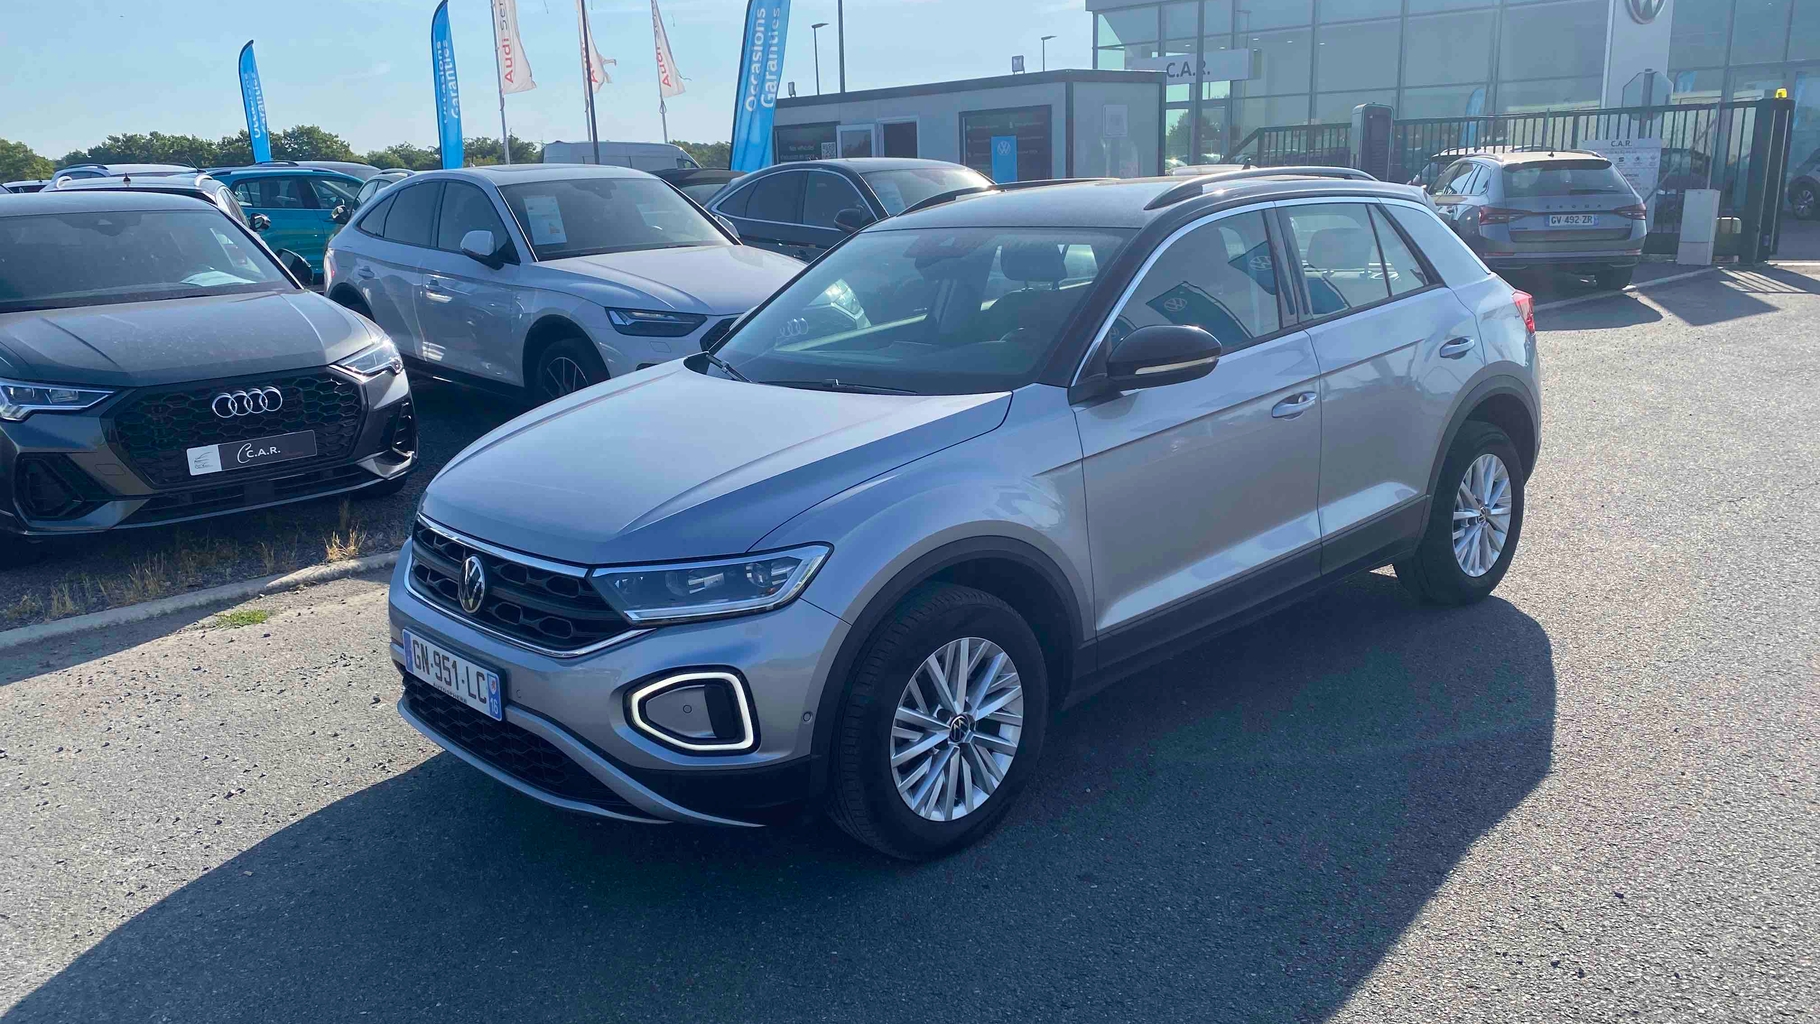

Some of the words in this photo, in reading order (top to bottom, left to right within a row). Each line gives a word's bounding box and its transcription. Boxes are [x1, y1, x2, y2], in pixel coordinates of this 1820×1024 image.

[502, 38, 513, 83] Audi
[745, 8, 766, 112] Occasions
[761, 8, 780, 108] Garanties
[489, 698, 499, 715] 16
